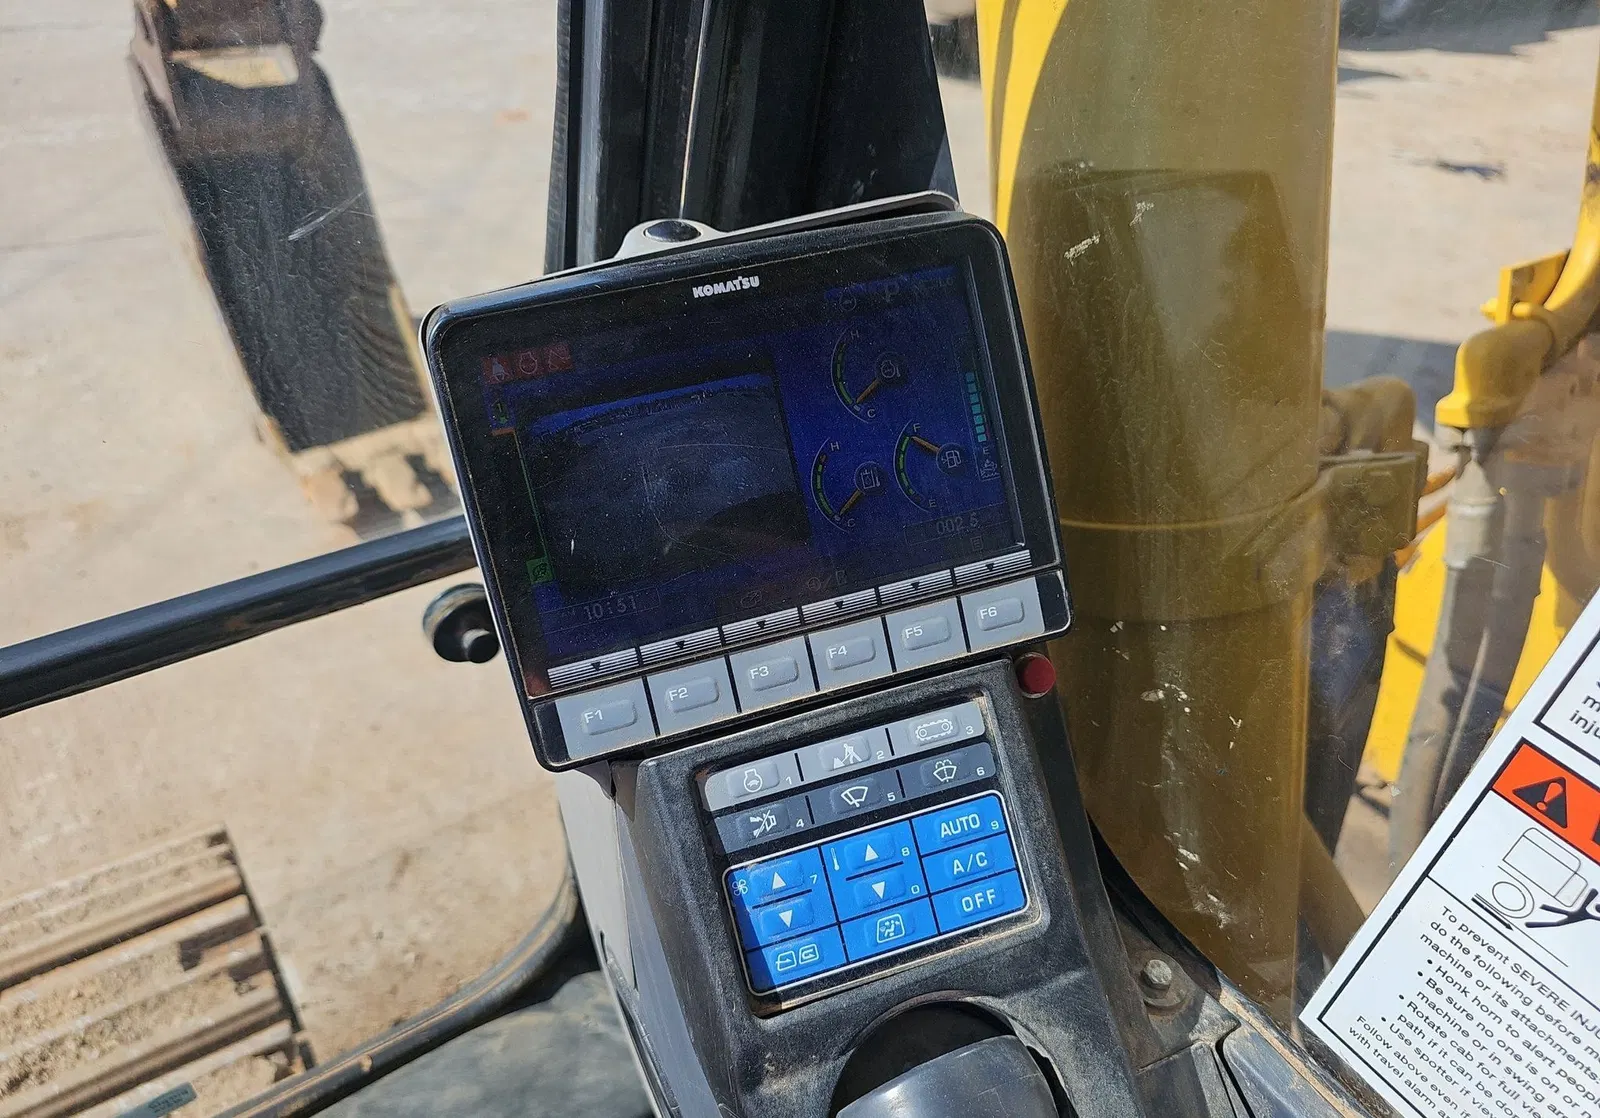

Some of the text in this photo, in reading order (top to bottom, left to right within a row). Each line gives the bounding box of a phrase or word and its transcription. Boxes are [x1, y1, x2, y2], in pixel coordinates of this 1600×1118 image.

[692, 276, 760, 298] KOMATSU
[850, 330, 860, 340] H
[867, 408, 876, 418] C
[913, 423, 921, 433] F
[830, 441, 840, 452] H
[983, 446, 990, 455] E
[929, 499, 937, 508] E
[847, 517, 856, 528] C
[979, 606, 998, 620] F6
[905, 625, 923, 639] F5
[828, 645, 848, 658] F4
[750, 666, 769, 679] F3
[669, 687, 688, 699] F2
[584, 710, 603, 723] F1
[965, 725, 974, 735] 3
[876, 750, 885, 760] 2
[976, 767, 985, 776] 6
[785, 776, 793, 785] 1
[887, 792, 896, 802] 5
[795, 818, 805, 828] 4
[939, 813, 981, 838] AUTO
[990, 820, 999, 830] 9
[901, 847, 910, 857] 8
[952, 852, 988, 875] A/C
[810, 874, 819, 884] 7
[911, 884, 920, 895] 0
[961, 889, 997, 913] OFF
[1441, 906, 1457, 923] To
[1458, 923, 1510, 965] prevent
[1510, 962, 1571, 1012] SEVERE
[1420, 933, 1473, 979] machine
[1475, 979, 1491, 992] or
[1491, 991, 1509, 1008] its
[1430, 921, 1447, 937] do
[1449, 935, 1471, 955] the
[1472, 954, 1533, 1007] following
[1535, 1004, 1582, 1045] before
[1426, 977, 1444, 996] Be
[1445, 996, 1474, 1022] sure
[1476, 1021, 1494, 1038] no
[1496, 1039, 1523, 1062] one
[1525, 1061, 1539, 1075] is
[1541, 1076, 1560, 1094] on
[1562, 1095, 1580, 1108] or
[1435, 965, 1600, 1108] Honk horn to alert peopl
[1406, 1000, 1448, 1039] Rotate
[1449, 1039, 1474, 1062] cab
[1476, 1061, 1497, 1080] for
[1497, 1079, 1521, 1100] full
[1416, 991, 1470, 1038] machine
[1472, 1039, 1488, 1052] or
[1488, 1051, 1502, 1066] in
[1503, 1066, 1546, 1103] swing
[1356, 1015, 1393, 1050] Follow
[1393, 1050, 1429, 1083] above
[1430, 1083, 1459, 1110] even
[1389, 1023, 1412, 1046] Use
[1414, 1046, 1460, 1087] spotter
[1459, 1086, 1472, 1097] if
[1397, 1014, 1426, 1040] path
[1427, 1038, 1439, 1049] if
[1438, 1047, 1449, 1059] it
[1450, 1059, 1474, 1082] can
[1475, 1081, 1493, 1098] be
[1349, 1026, 1371, 1050] with
[1372, 1048, 1405, 1079] travel
[1404, 1078, 1437, 1109] alarm
